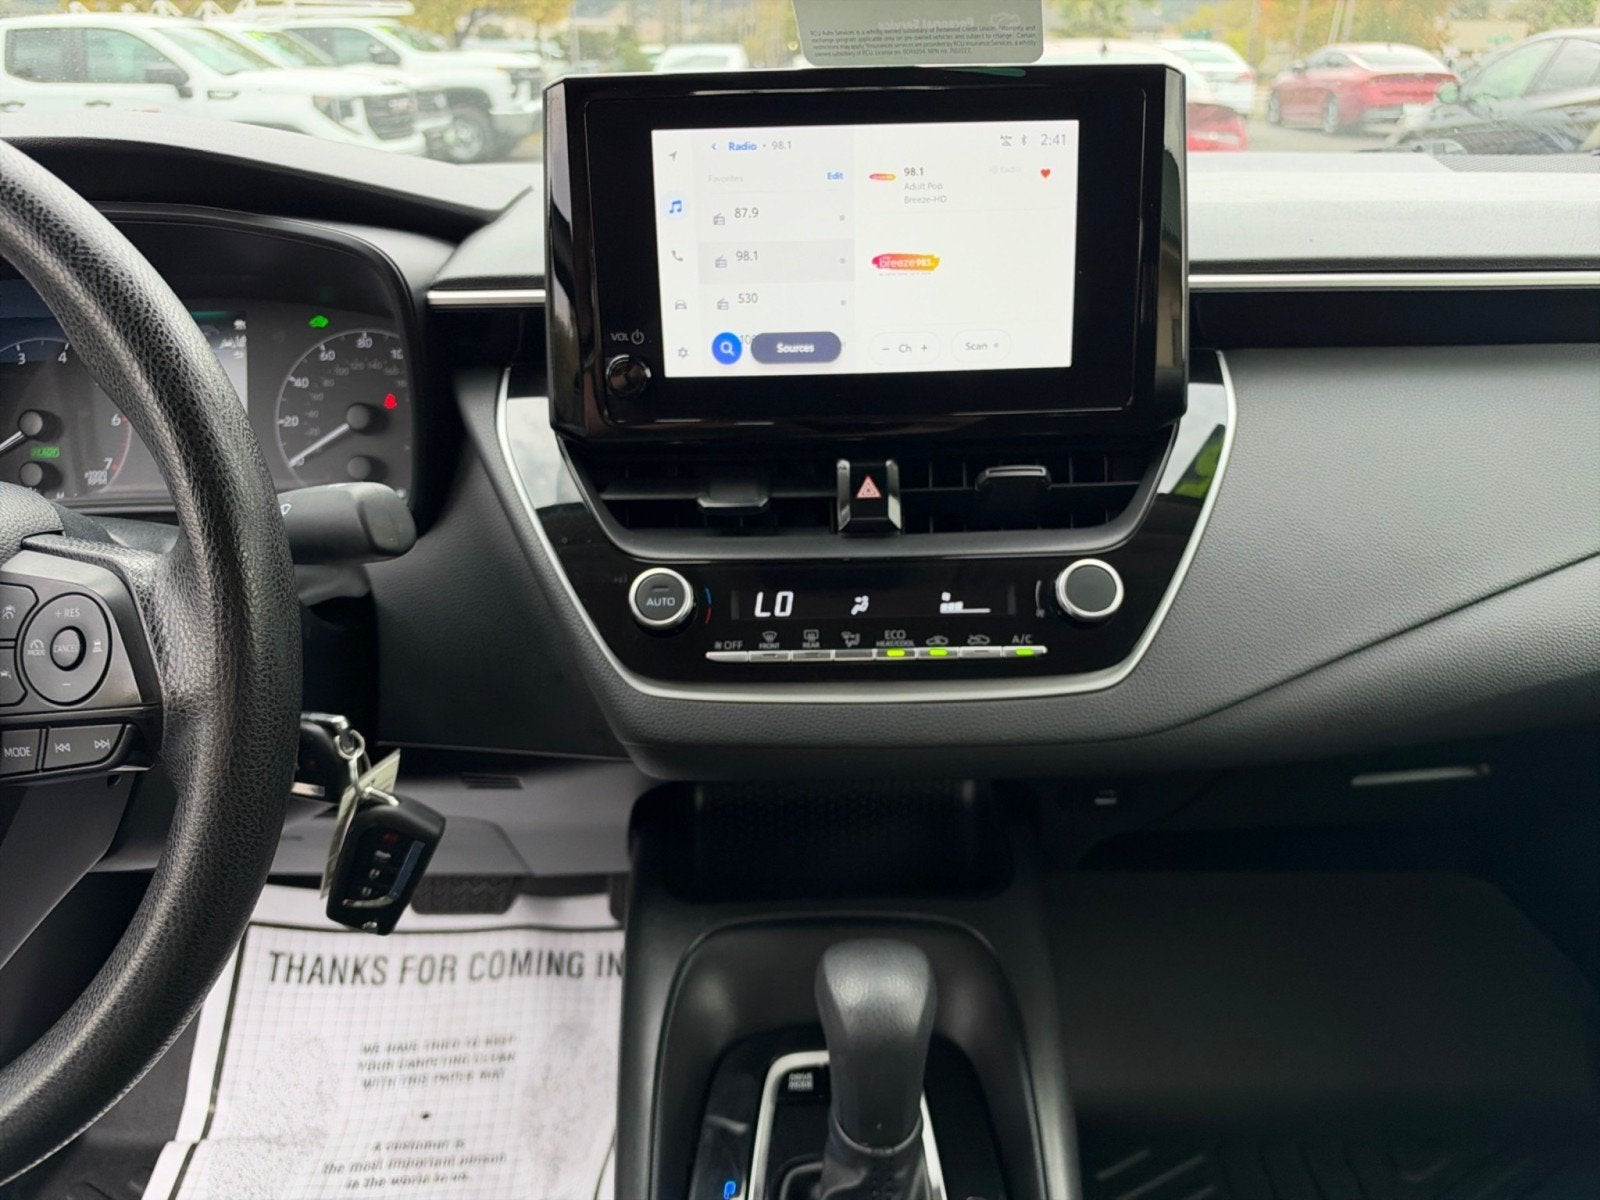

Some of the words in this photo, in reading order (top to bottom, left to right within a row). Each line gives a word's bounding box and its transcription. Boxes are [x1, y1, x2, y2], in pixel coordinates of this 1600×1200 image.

[728, 141, 757, 151] Radio
[771, 140, 792, 150] 98.1
[1040, 133, 1066, 146] 2:41
[826, 171, 844, 181] Edit
[903, 167, 924, 177] 98.1
[904, 182, 926, 191] Adult
[927, 182, 944, 192] Pop
[904, 195, 947, 205] Breeze-HD
[734, 207, 759, 219] 87.9
[735, 250, 759, 262] 98.1
[737, 293, 759, 304] 530
[610, 332, 629, 341] VOL
[356, 337, 373, 349] 80
[776, 342, 815, 354] Sources
[898, 343, 912, 353] Ch
[965, 341, 988, 351] Scan
[18, 353, 27, 365] 3
[57, 352, 68, 364] 4
[320, 350, 336, 362] 60
[293, 376, 309, 389] 40
[111, 413, 122, 427] 6
[284, 415, 299, 428] 20
[104, 457, 113, 471] 7
[646, 597, 676, 607] AUTO
[754, 591, 794, 618] LO
[884, 629, 906, 640] ECO
[1012, 635, 1032, 645] A/C
[724, 640, 744, 650] OFF
[4, 746, 31, 758] MODE
[268, 951, 389, 987] THANKS
[400, 952, 457, 986] FOR
[468, 949, 584, 982] COMING
[322, 1161, 345, 1174] the
